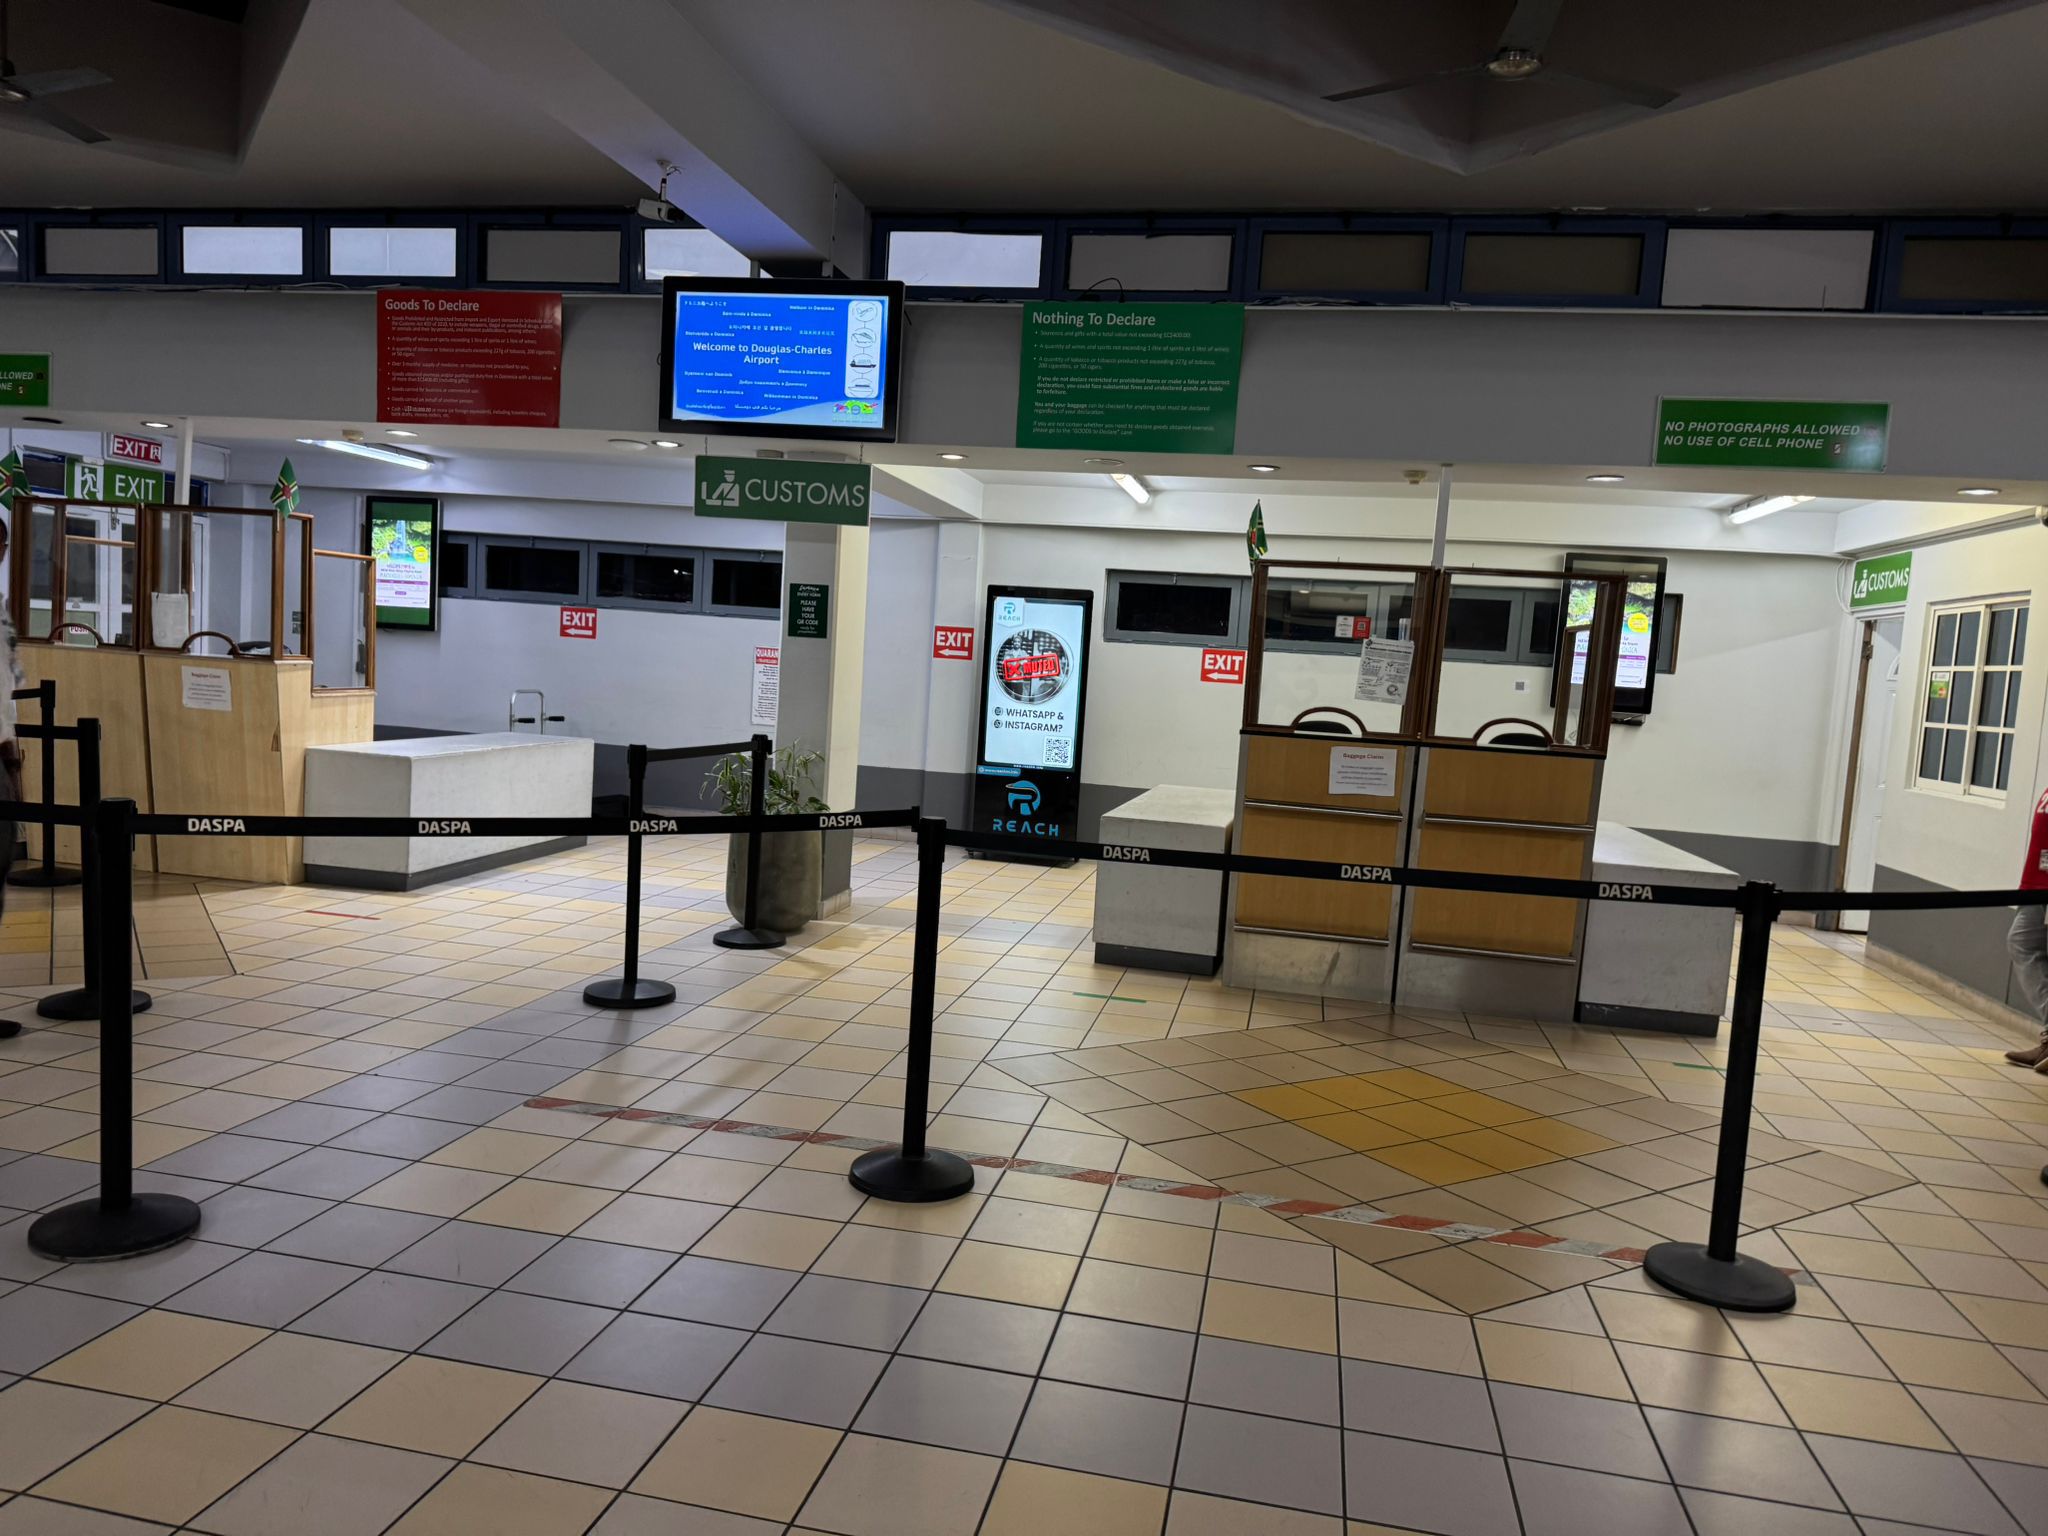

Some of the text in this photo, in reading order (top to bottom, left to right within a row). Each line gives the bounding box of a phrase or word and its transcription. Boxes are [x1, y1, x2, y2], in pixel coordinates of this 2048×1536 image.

[385, 299, 480, 311] Goods To Declare
[1032, 312, 1156, 327] Nothing To Declare
[693, 342, 736, 352] Welcome
[751, 344, 832, 356] Douglas-Charles
[743, 355, 780, 366] Airport
[1665, 422, 1860, 435] NO PHOTOGRAPHS ALLOWED
[113, 437, 149, 458] EXIT
[1664, 436, 1824, 449] NO USE OF CELL PHONE
[115, 474, 156, 500] EXIT
[745, 478, 865, 507] CUSTOMS
[1868, 568, 1909, 592] CUSTOMS
[562, 611, 595, 627] EXIT
[936, 631, 972, 647] EXIT
[1023, 657, 1055, 674] MUTED
[1205, 654, 1243, 671] EXIT
[1006, 708, 1056, 720] WHATSAPP
[1005, 721, 1063, 732] INSTAGRAM?
[187, 818, 246, 833] DASPA
[418, 821, 471, 834] DASPA
[630, 820, 678, 833] DASPA
[819, 815, 862, 828] DASPA
[992, 819, 1059, 837] REACH
[1103, 846, 1150, 862] DASPA
[1340, 865, 1392, 882] DASPA
[1599, 883, 1653, 900] DASPA
